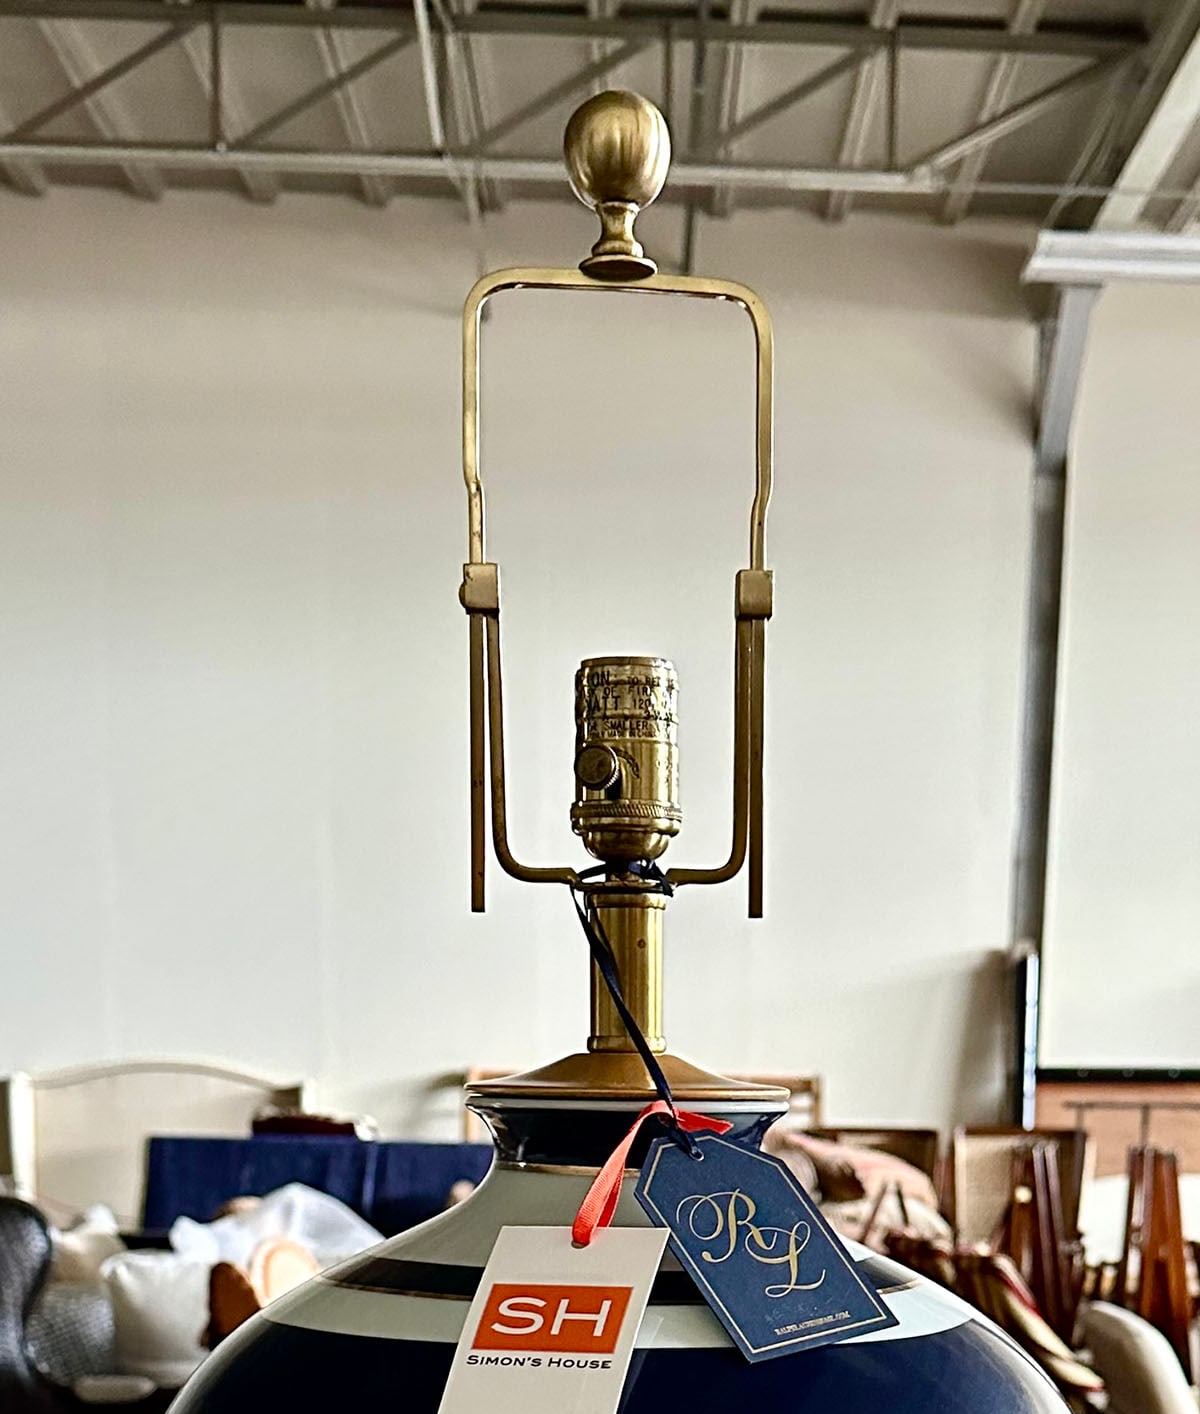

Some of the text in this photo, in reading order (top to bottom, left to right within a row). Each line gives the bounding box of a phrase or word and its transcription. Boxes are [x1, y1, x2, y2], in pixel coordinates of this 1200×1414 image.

[490, 1296, 612, 1337] SH
[466, 1355, 612, 1369] SIMON'S HOUSE
